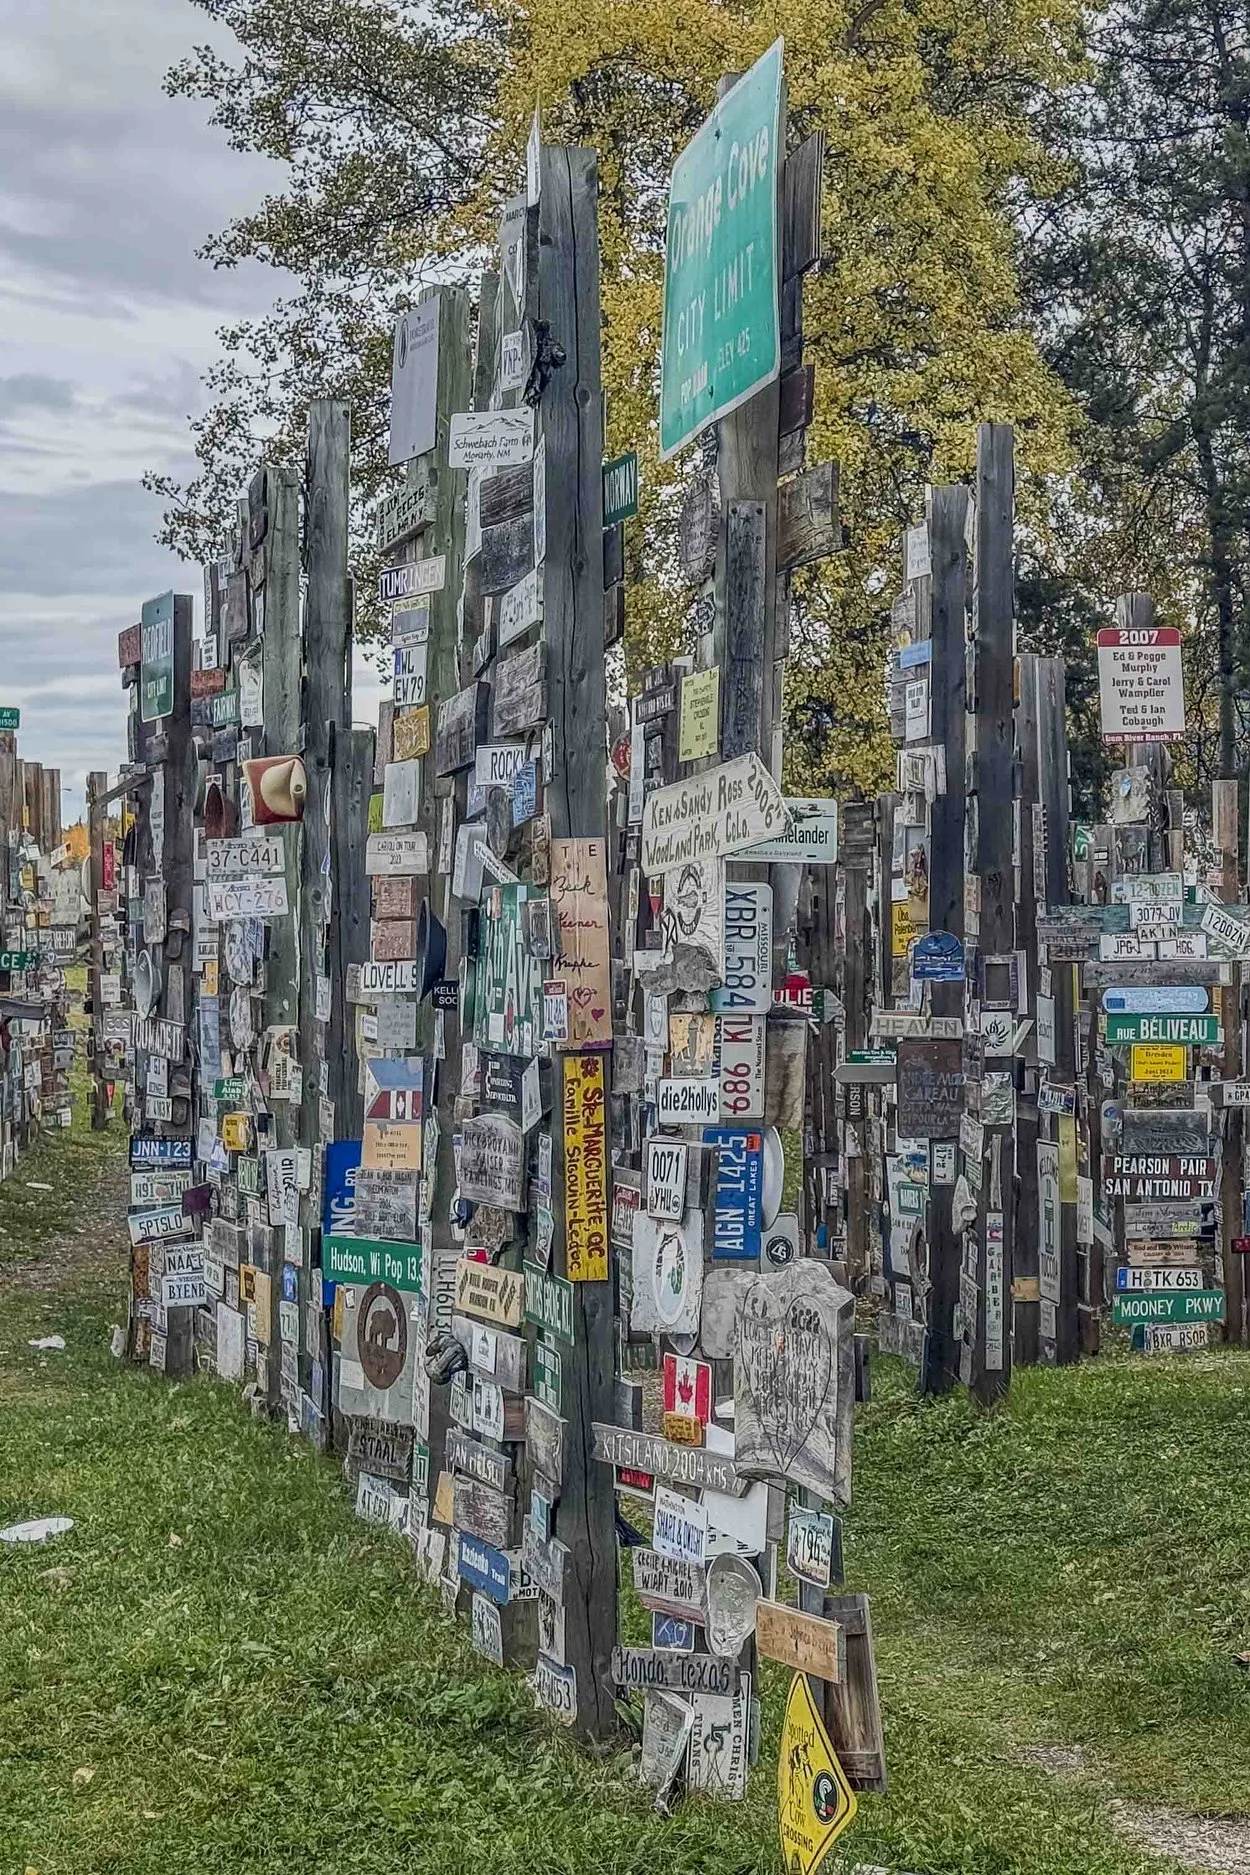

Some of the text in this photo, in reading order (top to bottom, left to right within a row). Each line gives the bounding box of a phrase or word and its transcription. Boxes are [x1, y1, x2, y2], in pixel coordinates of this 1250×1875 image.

[671, 125, 770, 273] Orange Cove
[676, 240, 755, 357] CITY LIMIT
[454, 437, 497, 450] Schwebach
[604, 460, 636, 512] NORWAY
[1119, 630, 1159, 645] 2007
[1113, 652, 1126, 661] Ed
[1128, 652, 1134, 660] &
[1122, 663, 1158, 673] Murphy
[1112, 677, 1171, 688] Jerry & Carol
[1120, 705, 1138, 715] Ted
[1141, 706, 1148, 714] &
[1122, 716, 1163, 727] Cobaugh
[724, 889, 757, 1007] XBR 584
[363, 964, 406, 989] LOVELL
[876, 1018, 958, 1035] HEAVEN
[1117, 1014, 1208, 1040] RUE BÉLIVEAU
[661, 1086, 718, 1112] die2hollys
[1113, 1157, 1207, 1175] PEARSON PAIR
[714, 1135, 748, 1251] AGN 1425
[748, 1160, 759, 1227] GREAT LAKES
[1105, 1179, 1214, 1197] SAN ANTONIO TX
[331, 1248, 402, 1281] Hudson, Wi Pop
[1132, 1271, 1143, 1285] H
[1176, 1271, 1199, 1286] 653
[1120, 1296, 1223, 1317] MOONEY PKWY
[602, 1435, 670, 1474] KITSILANO
[671, 1450, 705, 1481] 2004
[676, 1655, 730, 1691] Texas
[787, 1715, 815, 1748] Spotted
[789, 1803, 807, 1828] Cow
[782, 1823, 815, 1853] CROSSING
